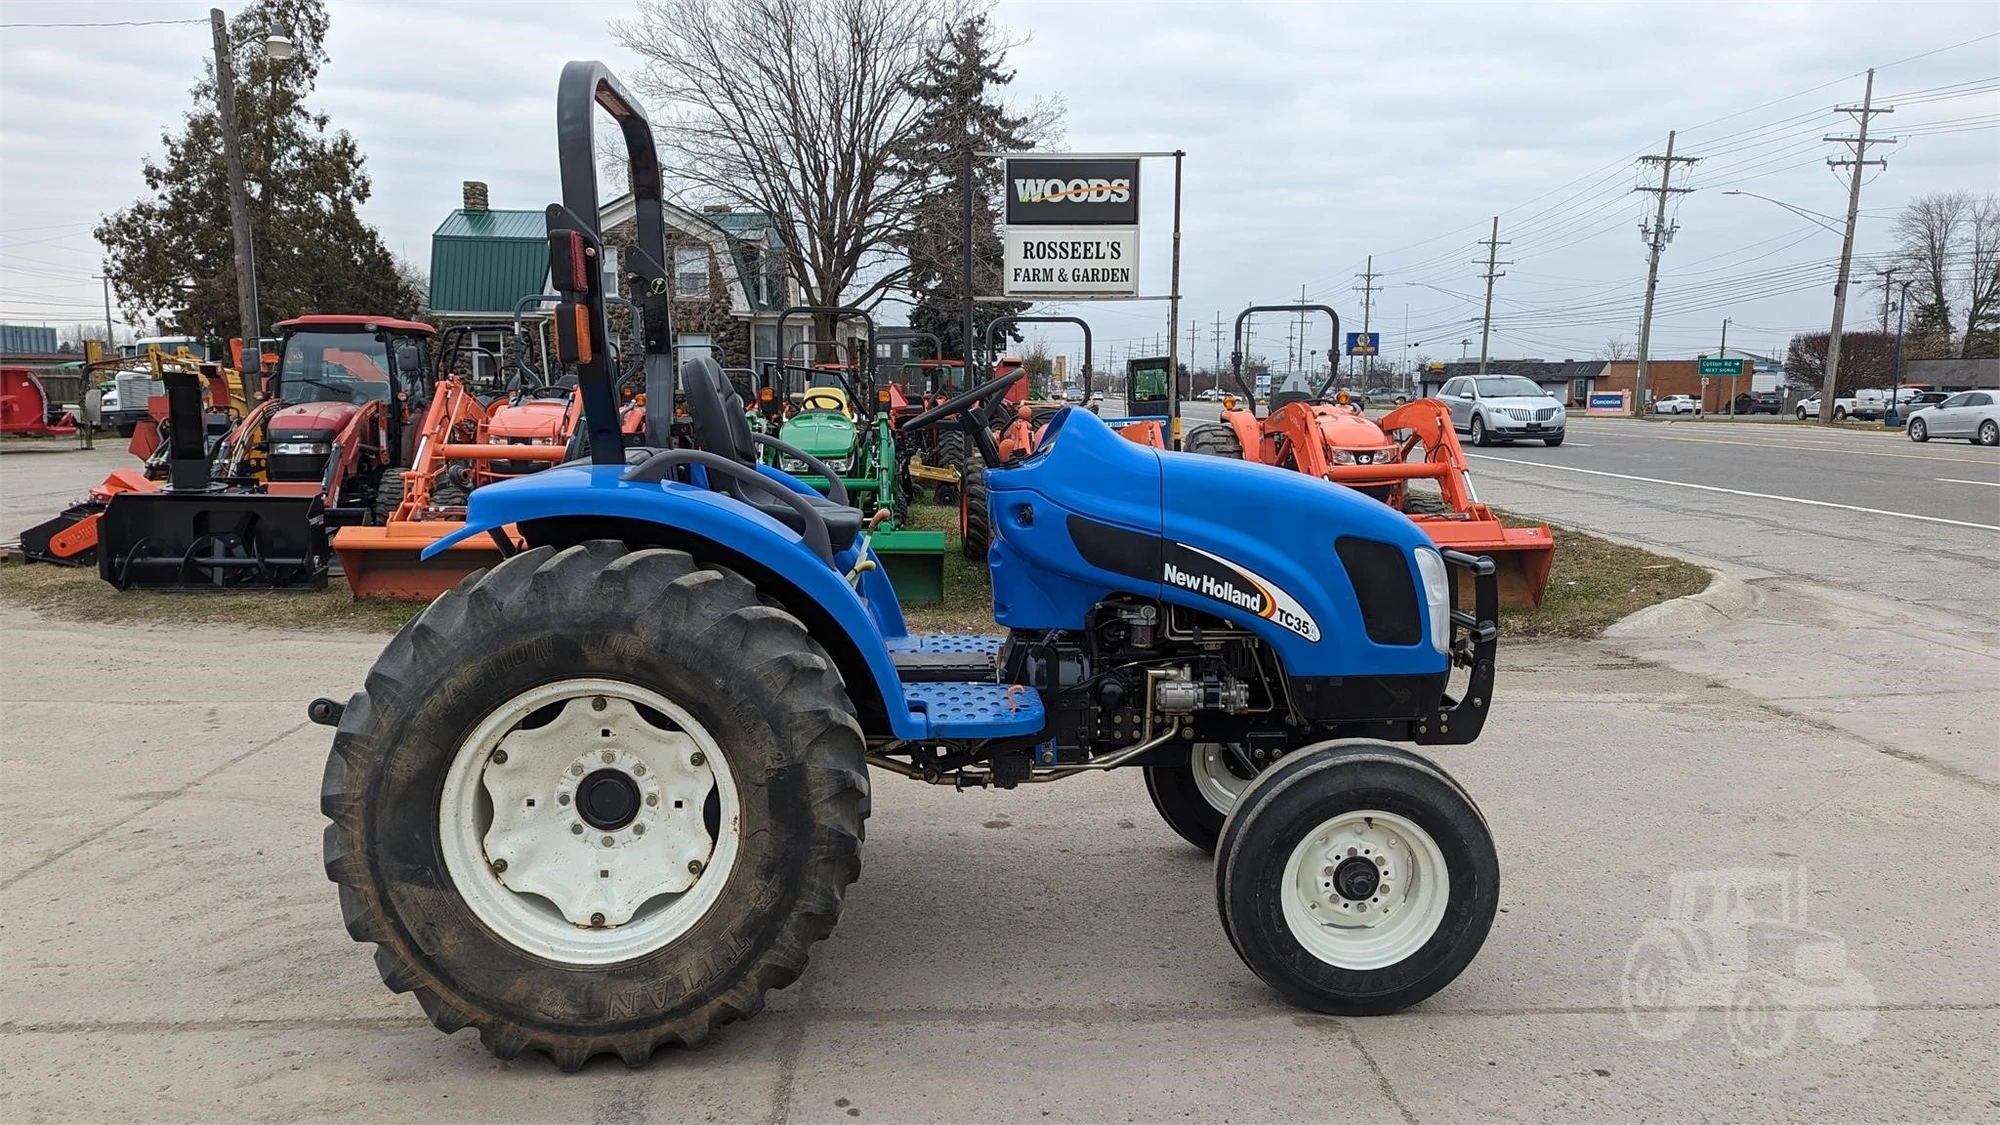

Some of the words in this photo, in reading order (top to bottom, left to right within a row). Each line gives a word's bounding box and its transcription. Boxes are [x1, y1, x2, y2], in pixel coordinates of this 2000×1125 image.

[1014, 178, 1130, 203] WOODS
[1022, 240, 1121, 260] ROSSEEL'S
[1013, 267, 1054, 283] FARM
[1057, 267, 1069, 283] &
[1071, 267, 1130, 283] GARDEN
[1164, 562, 1201, 591] New
[1202, 574, 1261, 613] Holland
[604, 924, 751, 1022] TITAN
